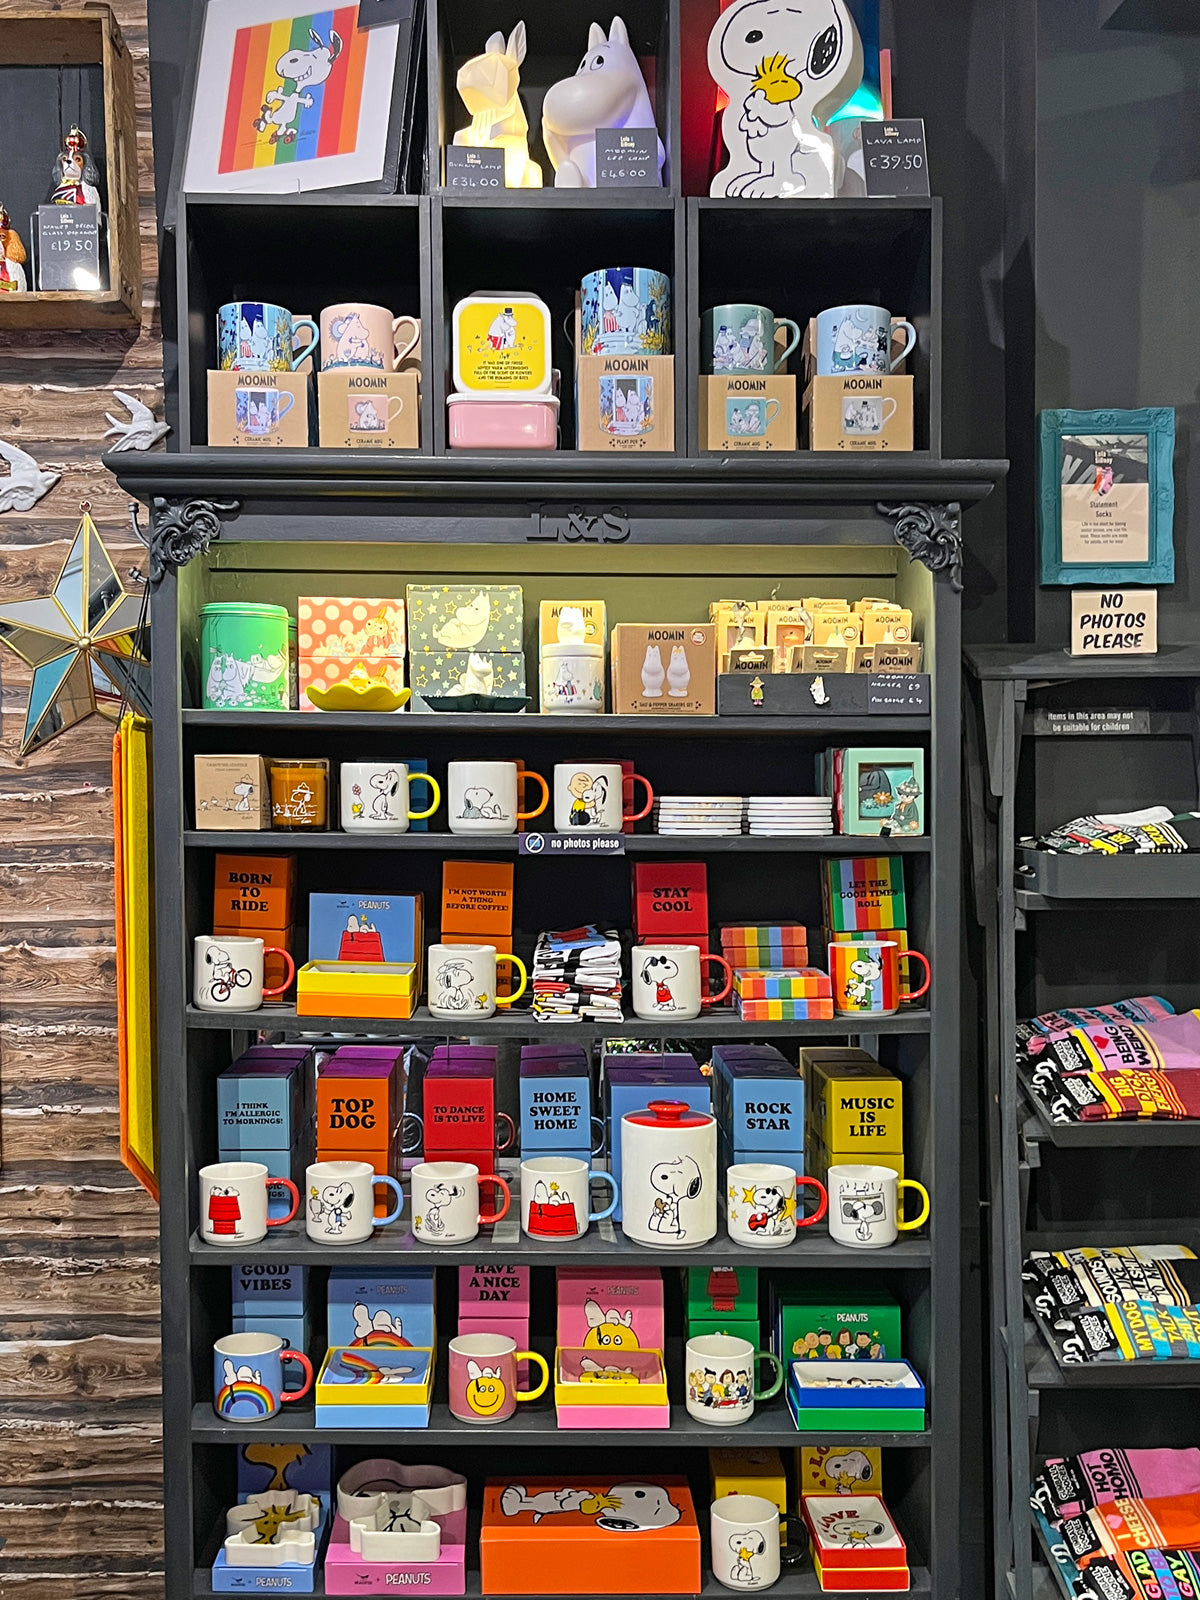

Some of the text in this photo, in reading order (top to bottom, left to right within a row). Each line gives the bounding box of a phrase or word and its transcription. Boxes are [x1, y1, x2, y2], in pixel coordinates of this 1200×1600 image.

[604, 359, 649, 372] MOOMIN
[238, 375, 277, 386] MOOMIN
[348, 377, 387, 388] MOOMIN
[727, 380, 766, 391] MOOMIN
[843, 379, 883, 390] MOOMIN
[1095, 510, 1112, 518] Socks
[1100, 593, 1124, 609] NO
[1080, 612, 1146, 630] PHOTOS
[648, 630, 685, 641] MOOMIN
[1082, 633, 1144, 649] PLEASE
[734, 661, 769, 670] MOOMIN
[879, 657, 913, 666] MOOMIN
[1068, 712, 1075, 720] in
[1076, 711, 1088, 720] this
[1107, 713, 1121, 722] may
[1123, 712, 1134, 720] not
[1052, 722, 1130, 732] be suitable for children
[551, 838, 620, 850] no photos please
[229, 872, 273, 884] BORN
[848, 879, 888, 889] LET THE
[240, 887, 261, 897] TO
[653, 887, 691, 899] STAY
[840, 888, 899, 899] GOOD TIMES
[231, 900, 269, 912] RIDE
[358, 900, 391, 910] PEANUTS
[652, 901, 693, 913] COOL
[857, 900, 882, 908] ROLL
[1105, 1026, 1136, 1064] BEING
[1119, 1025, 1152, 1066] WEIRD
[1109, 1077, 1135, 1098] BIG
[1139, 1070, 1172, 1111] ENERGY
[533, 1092, 577, 1103] HOME
[840, 1097, 895, 1110] MUSIC
[331, 1099, 374, 1113] TOP
[434, 1106, 485, 1114] TO DANCE
[529, 1105, 582, 1116] SWEET
[744, 1102, 792, 1114] ROCK
[329, 1114, 376, 1129] DOG
[859, 1111, 876, 1123] IS
[534, 1119, 578, 1130] HOME
[746, 1118, 791, 1130] STAR
[849, 1125, 887, 1137] LIFE
[241, 1265, 290, 1275] GOOD
[474, 1265, 516, 1274] HAVE
[240, 1278, 292, 1291] VIBES
[469, 1277, 520, 1288] A NICE
[1089, 1260, 1122, 1303] SOUNDS
[376, 1285, 408, 1295] PEANUTS
[479, 1290, 511, 1301] DAY
[607, 1286, 640, 1296] PEANUTS
[836, 1313, 869, 1323] PEANUTS
[1122, 1301, 1154, 1351] MY DOG
[1156, 1308, 1185, 1343] TALK
[1086, 1463, 1111, 1493] HOT
[1100, 1452, 1129, 1502] HOMO
[817, 1510, 860, 1528] LOVE
[1115, 1498, 1151, 1547] CHEESE
[385, 1573, 431, 1585] PEANUTS
[1131, 1551, 1162, 1599] GLAD
[1148, 1549, 1181, 1599] TO BE
[1165, 1556, 1194, 1597] GAY
[255, 1577, 292, 1587] PEANUTS
